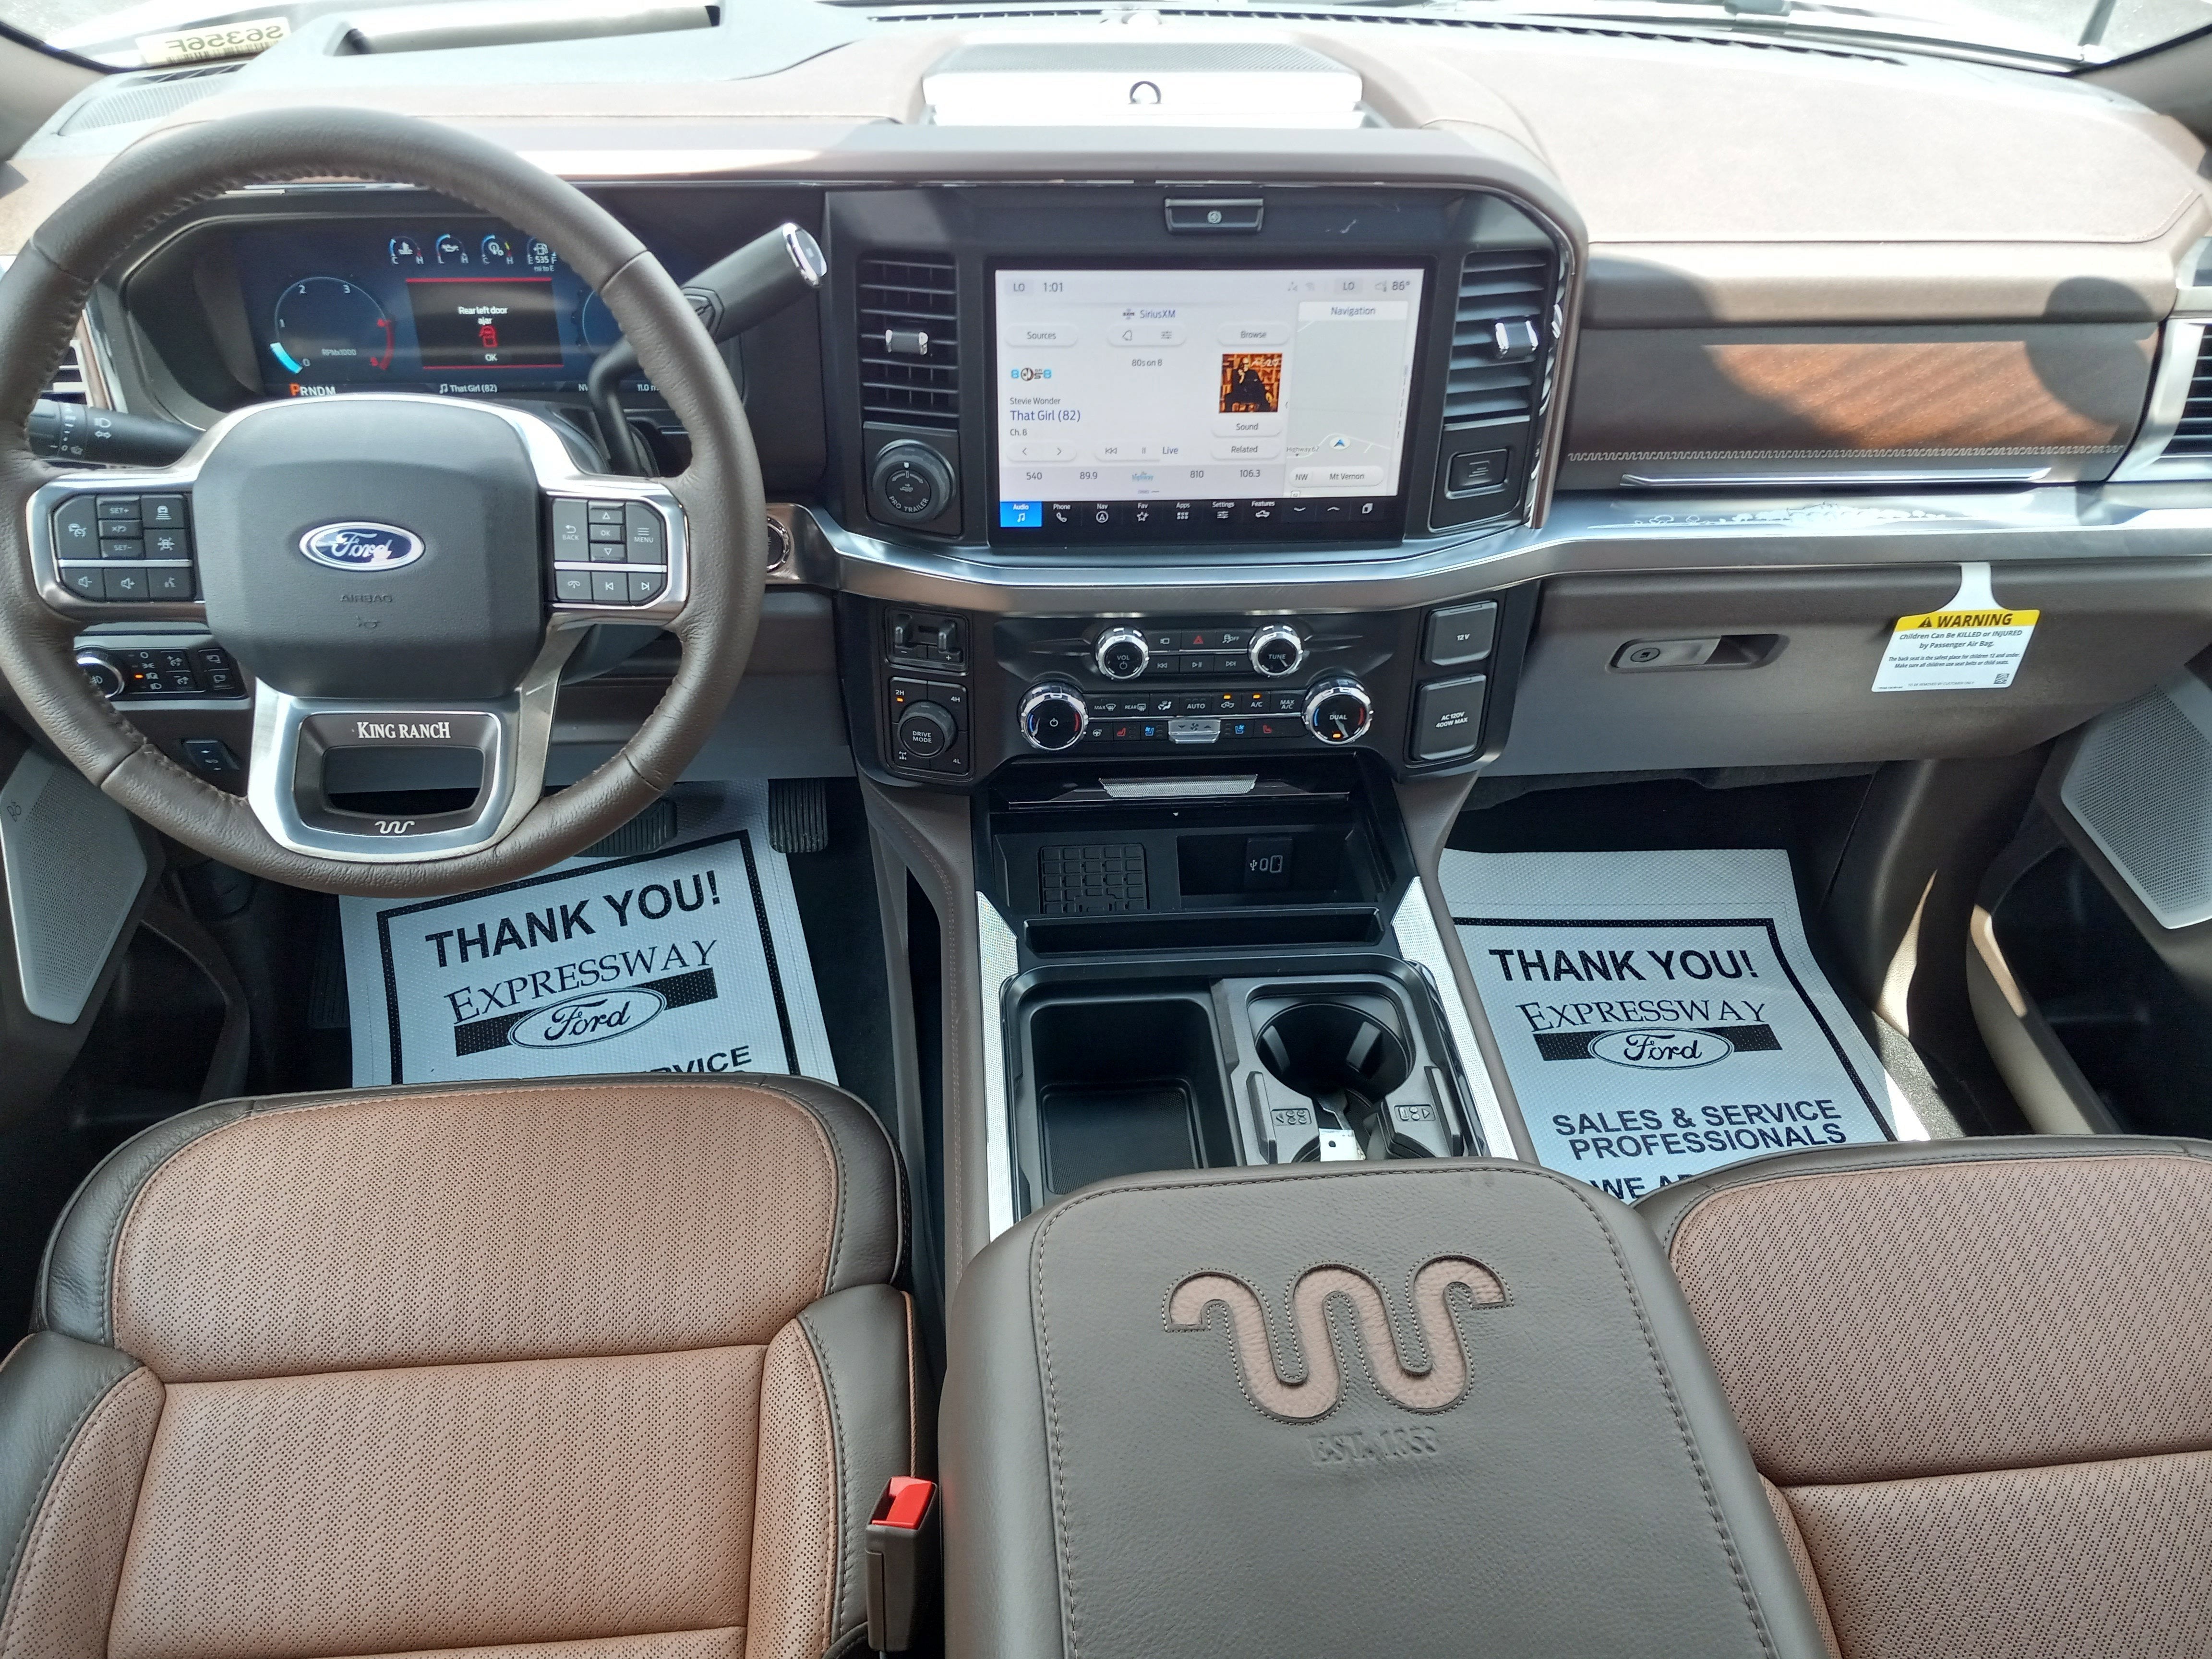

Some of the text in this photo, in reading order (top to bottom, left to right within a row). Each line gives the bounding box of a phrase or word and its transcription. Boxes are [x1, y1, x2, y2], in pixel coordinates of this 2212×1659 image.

[299, 285, 307, 294] 2
[343, 284, 350, 294] 3
[1043, 282, 1064, 293] 1:01
[458, 306, 508, 315] Rear left door
[1139, 310, 1176, 319] SiriusXM
[1331, 306, 1376, 317] Navigation
[478, 317, 493, 326] ajar
[1027, 331, 1056, 340] Sources
[1241, 330, 1267, 339] Browse
[1132, 359, 1145, 367] 80s
[1157, 359, 1163, 367] 8
[468, 385, 480, 393] Girl
[481, 384, 498, 393] (82)
[1010, 397, 1061, 405] Stevie Wonder
[1010, 409, 1081, 422] That Girl (82)
[1236, 422, 1259, 431] Sound
[1010, 428, 1022, 436] Ch.
[1162, 446, 1178, 455] Live
[1231, 445, 1258, 454] Related
[1026, 472, 1043, 480] 540
[1080, 471, 1098, 480] 89.9
[1190, 470, 1204, 479] 810
[1239, 469, 1261, 478] 106.3
[889, 496, 928, 512] PRO TRAILER
[331, 531, 393, 560] Ford
[1937, 613, 2013, 628] WARNING
[1450, 711, 1465, 720] 120V
[1435, 717, 1469, 728] 400W MAX
[357, 721, 451, 739] KING RANCH
[425, 869, 721, 968] THANK YOU!
[1488, 949, 1759, 982] THANK YOU!
[444, 939, 718, 1025] EXPRESSWAY
[544, 998, 631, 1041] Ford
[1515, 998, 1766, 1033] EXPRESSWAY
[1623, 1034, 1702, 1061] Ford
[1552, 1099, 1842, 1136] SALES & SERVICE
[1569, 1123, 1848, 1161] PROFESSIONALS
